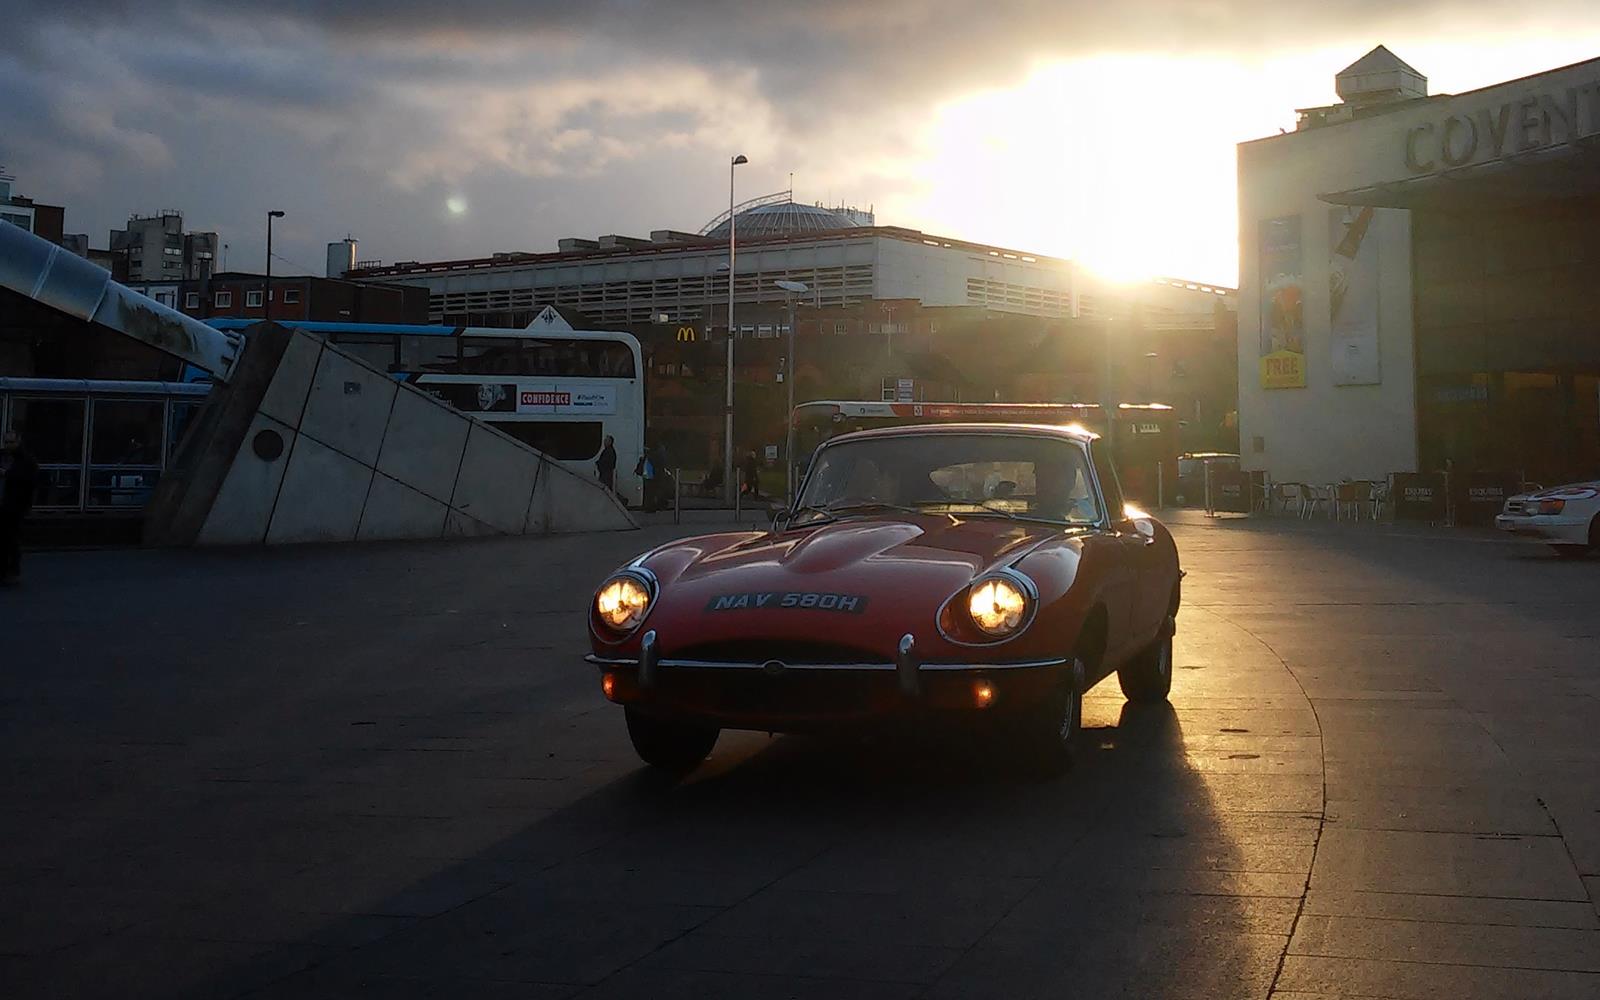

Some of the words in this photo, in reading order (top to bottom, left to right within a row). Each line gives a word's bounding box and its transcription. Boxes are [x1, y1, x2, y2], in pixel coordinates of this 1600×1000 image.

[1265, 357, 1299, 376] FREE
[522, 393, 569, 404] CONFIDENCE
[713, 593, 772, 610] NAV
[780, 593, 859, 611] 580H
